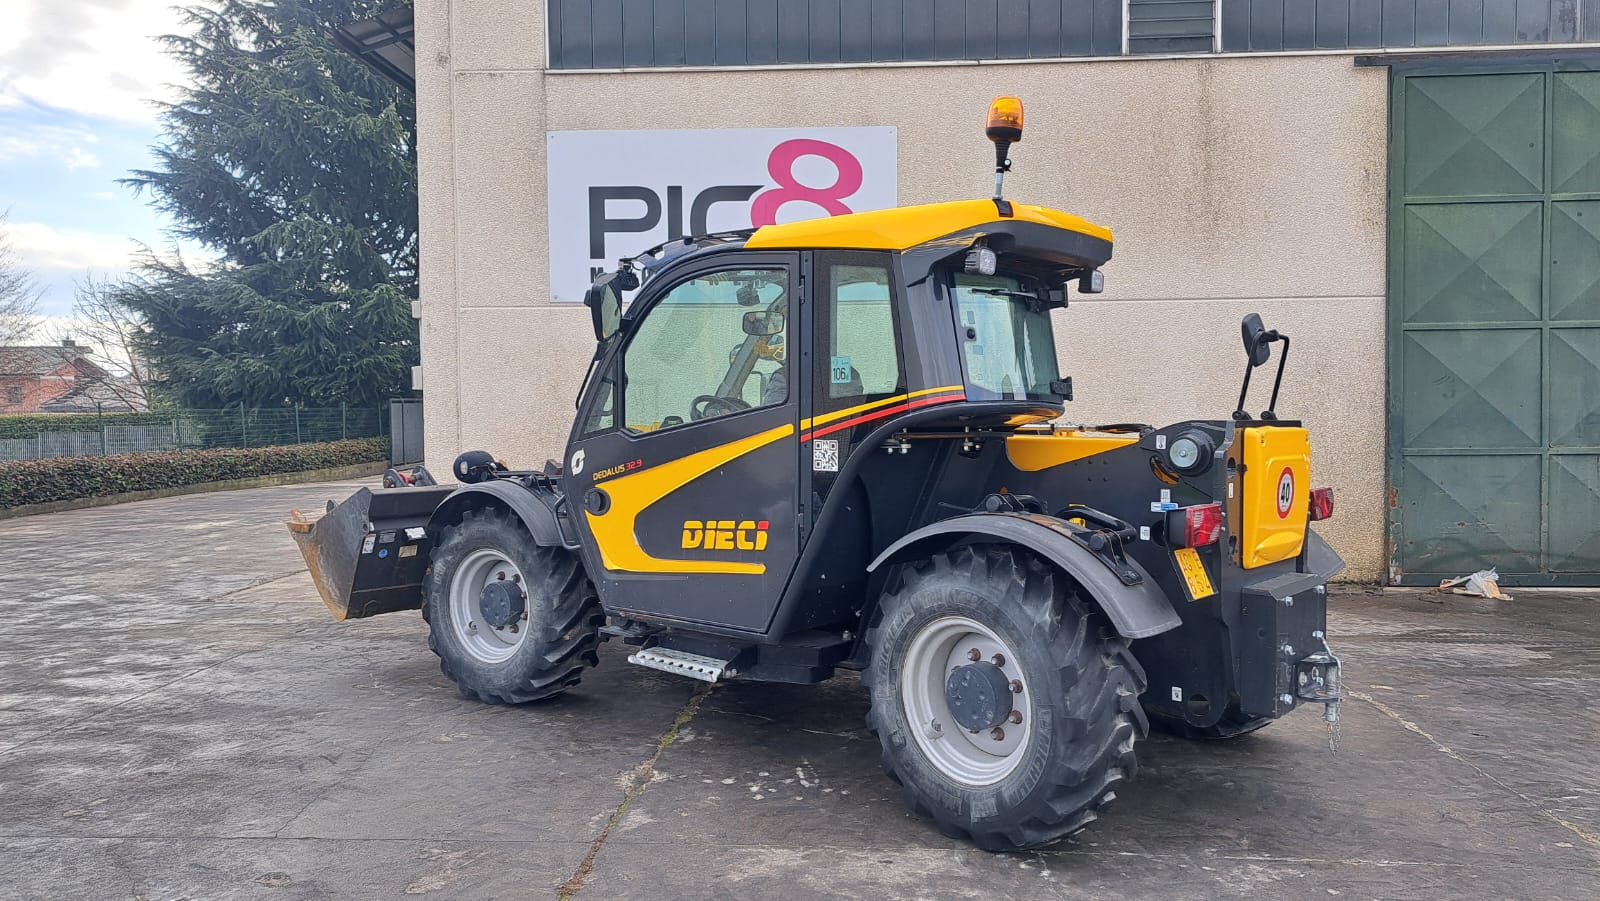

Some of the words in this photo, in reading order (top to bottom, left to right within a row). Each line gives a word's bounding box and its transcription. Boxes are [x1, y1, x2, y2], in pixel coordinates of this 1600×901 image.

[833, 367, 846, 380] 106
[593, 463, 625, 480] DEDALUS
[625, 458, 643, 471] 32.9
[1281, 482, 1290, 503] 40
